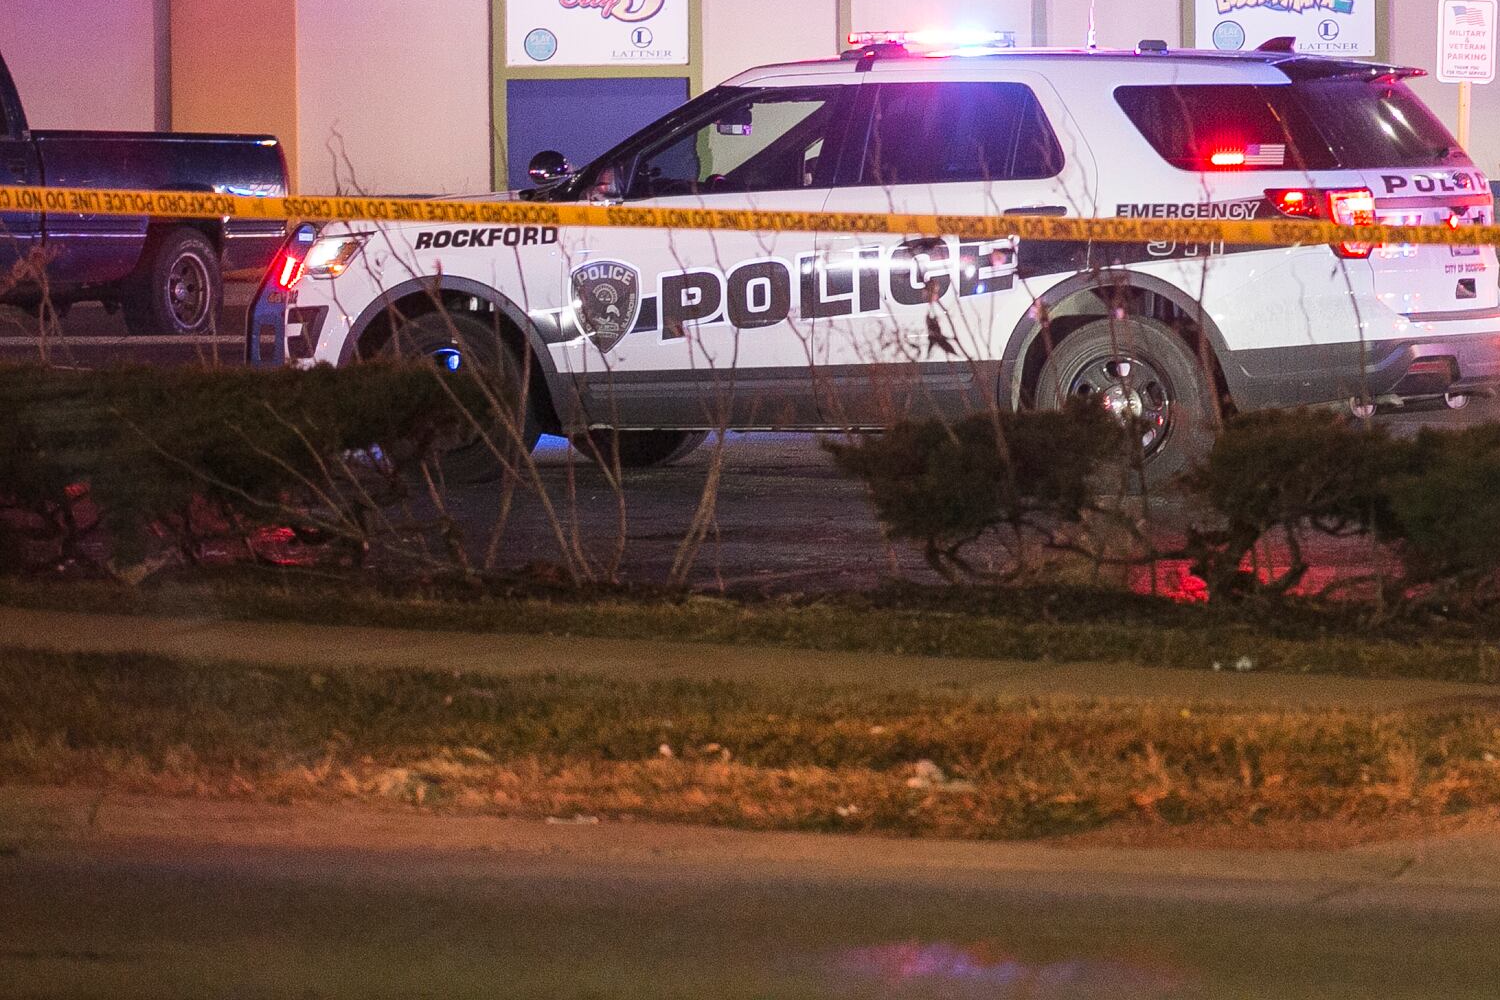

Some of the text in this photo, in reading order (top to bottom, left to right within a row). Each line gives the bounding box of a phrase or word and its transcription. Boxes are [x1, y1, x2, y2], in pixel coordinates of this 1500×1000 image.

[1299, 42, 1358, 50] LATTNER
[1447, 53, 1487, 61] PARKING
[15, 191, 42, 208] NOT
[46, 193, 67, 208] DO
[70, 193, 100, 209] LINE
[103, 194, 153, 210] POLICE
[158, 195, 236, 213] ROCKFORD
[283, 199, 558, 223] ROCKFORD POLICE LINE DO NOT CROSS
[1116, 203, 1257, 219] EMERGENCY
[608, 209, 888, 232] ROCKFORD POLICE LINE DO NOT CROSS
[415, 226, 559, 250] ROCKFORD
[577, 265, 634, 286] POLICE
[661, 237, 1018, 341] POLICE
